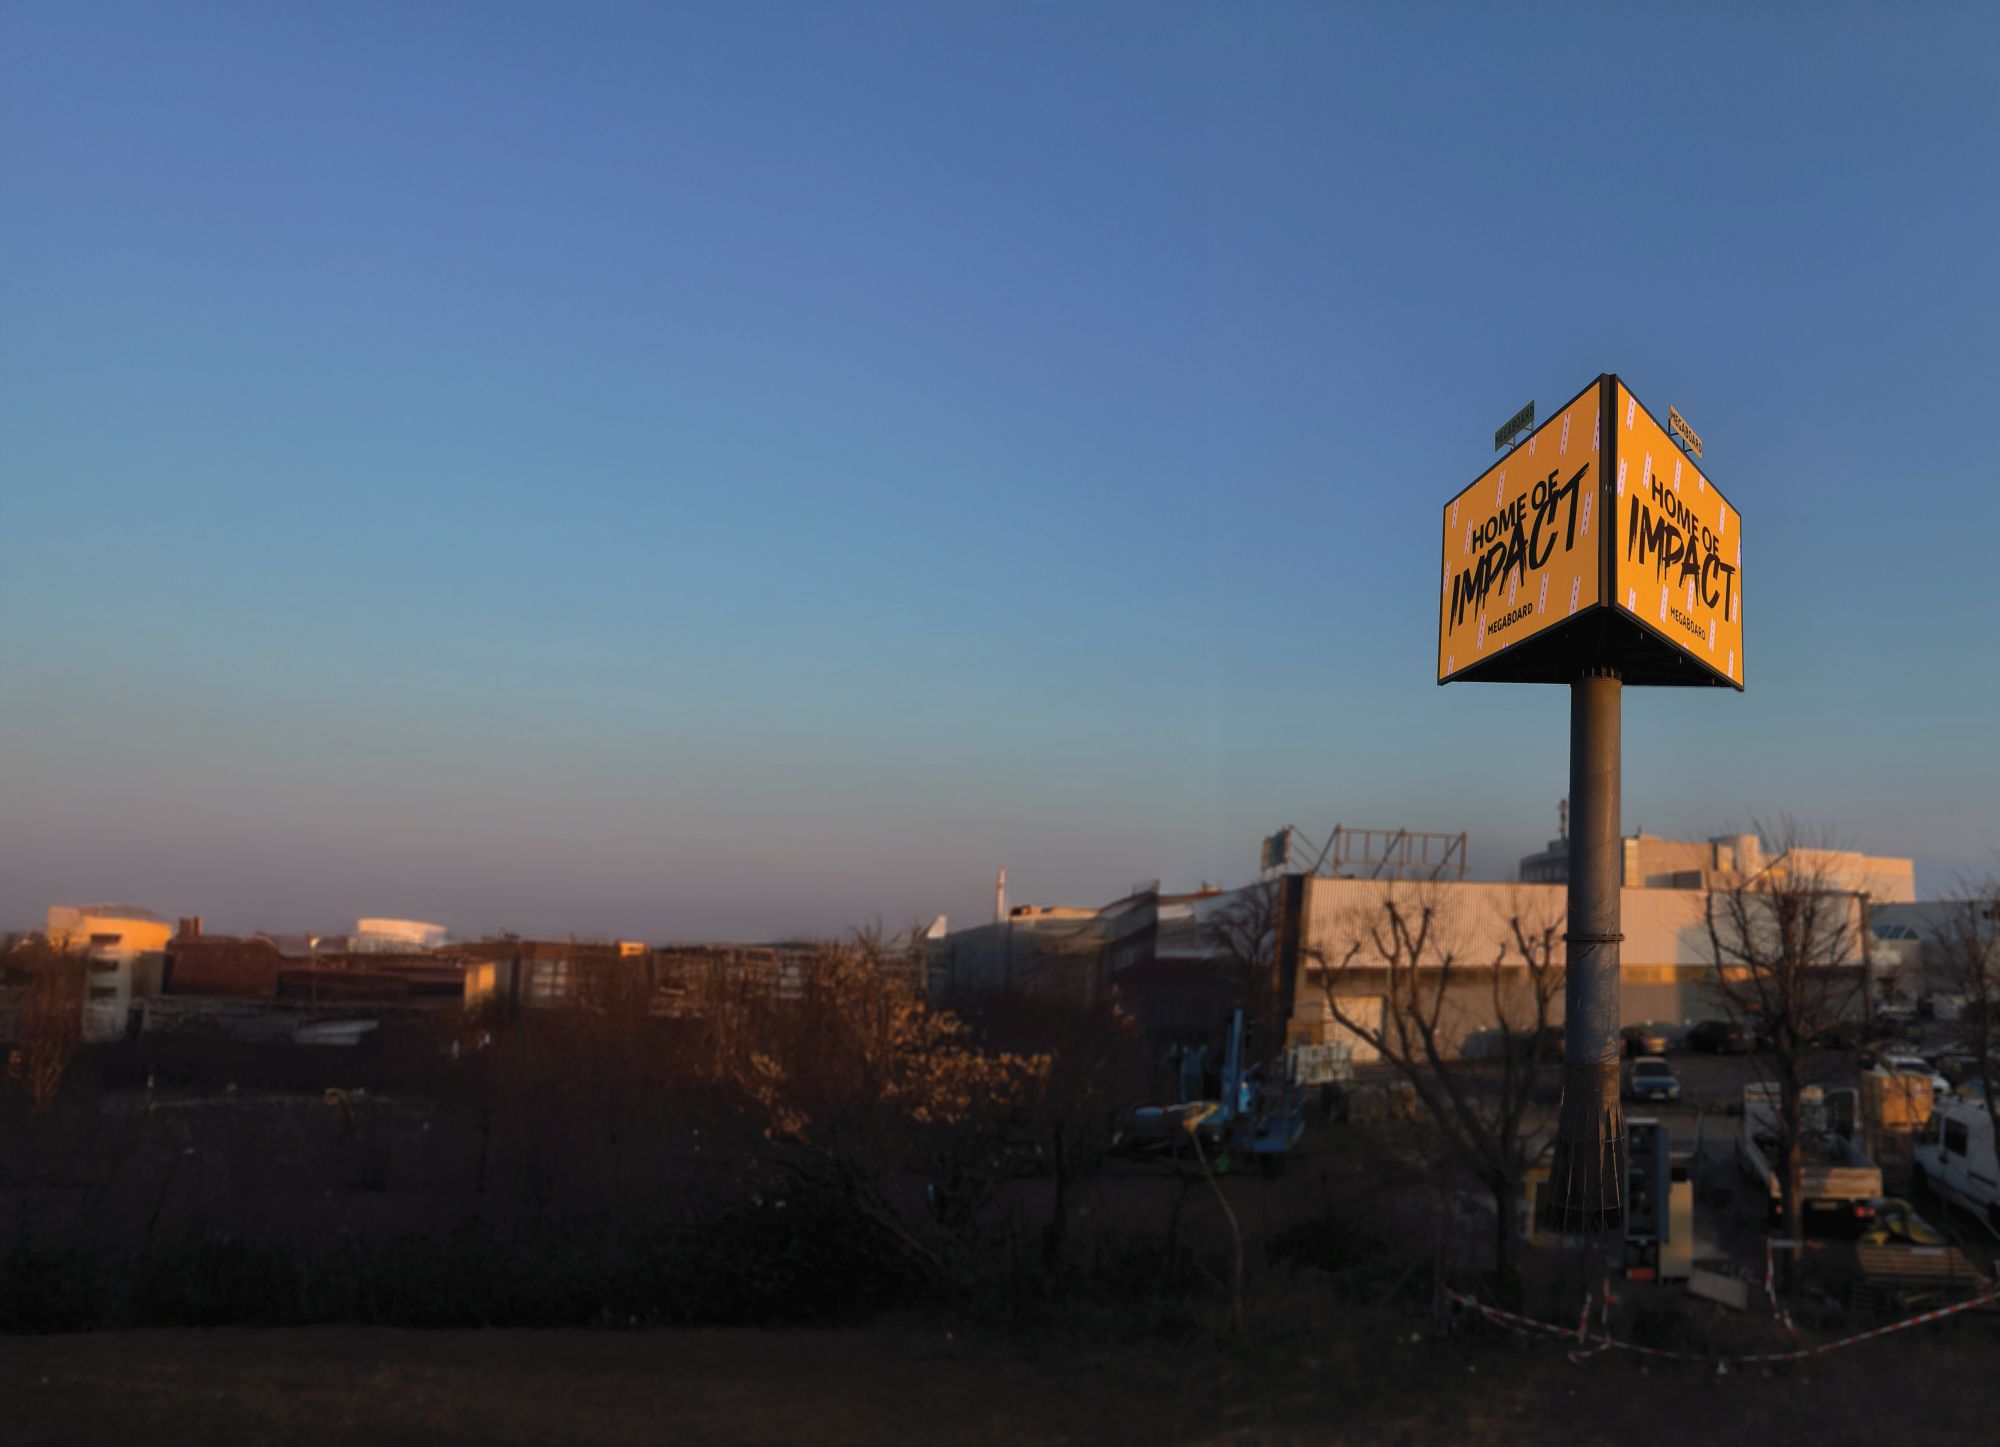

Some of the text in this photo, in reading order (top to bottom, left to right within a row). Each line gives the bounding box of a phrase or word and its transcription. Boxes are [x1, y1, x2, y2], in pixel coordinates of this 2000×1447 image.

[1672, 412, 1702, 453] MEGABOARD
[1449, 462, 1590, 637] IMPACT
[1472, 468, 1559, 555] HOME OF
[1652, 473, 1719, 557] HOME OF
[1628, 493, 1735, 622] IMPACT
[1488, 602, 1533, 636] MEGABOARD
[1670, 606, 1705, 640] MEGABOARD
